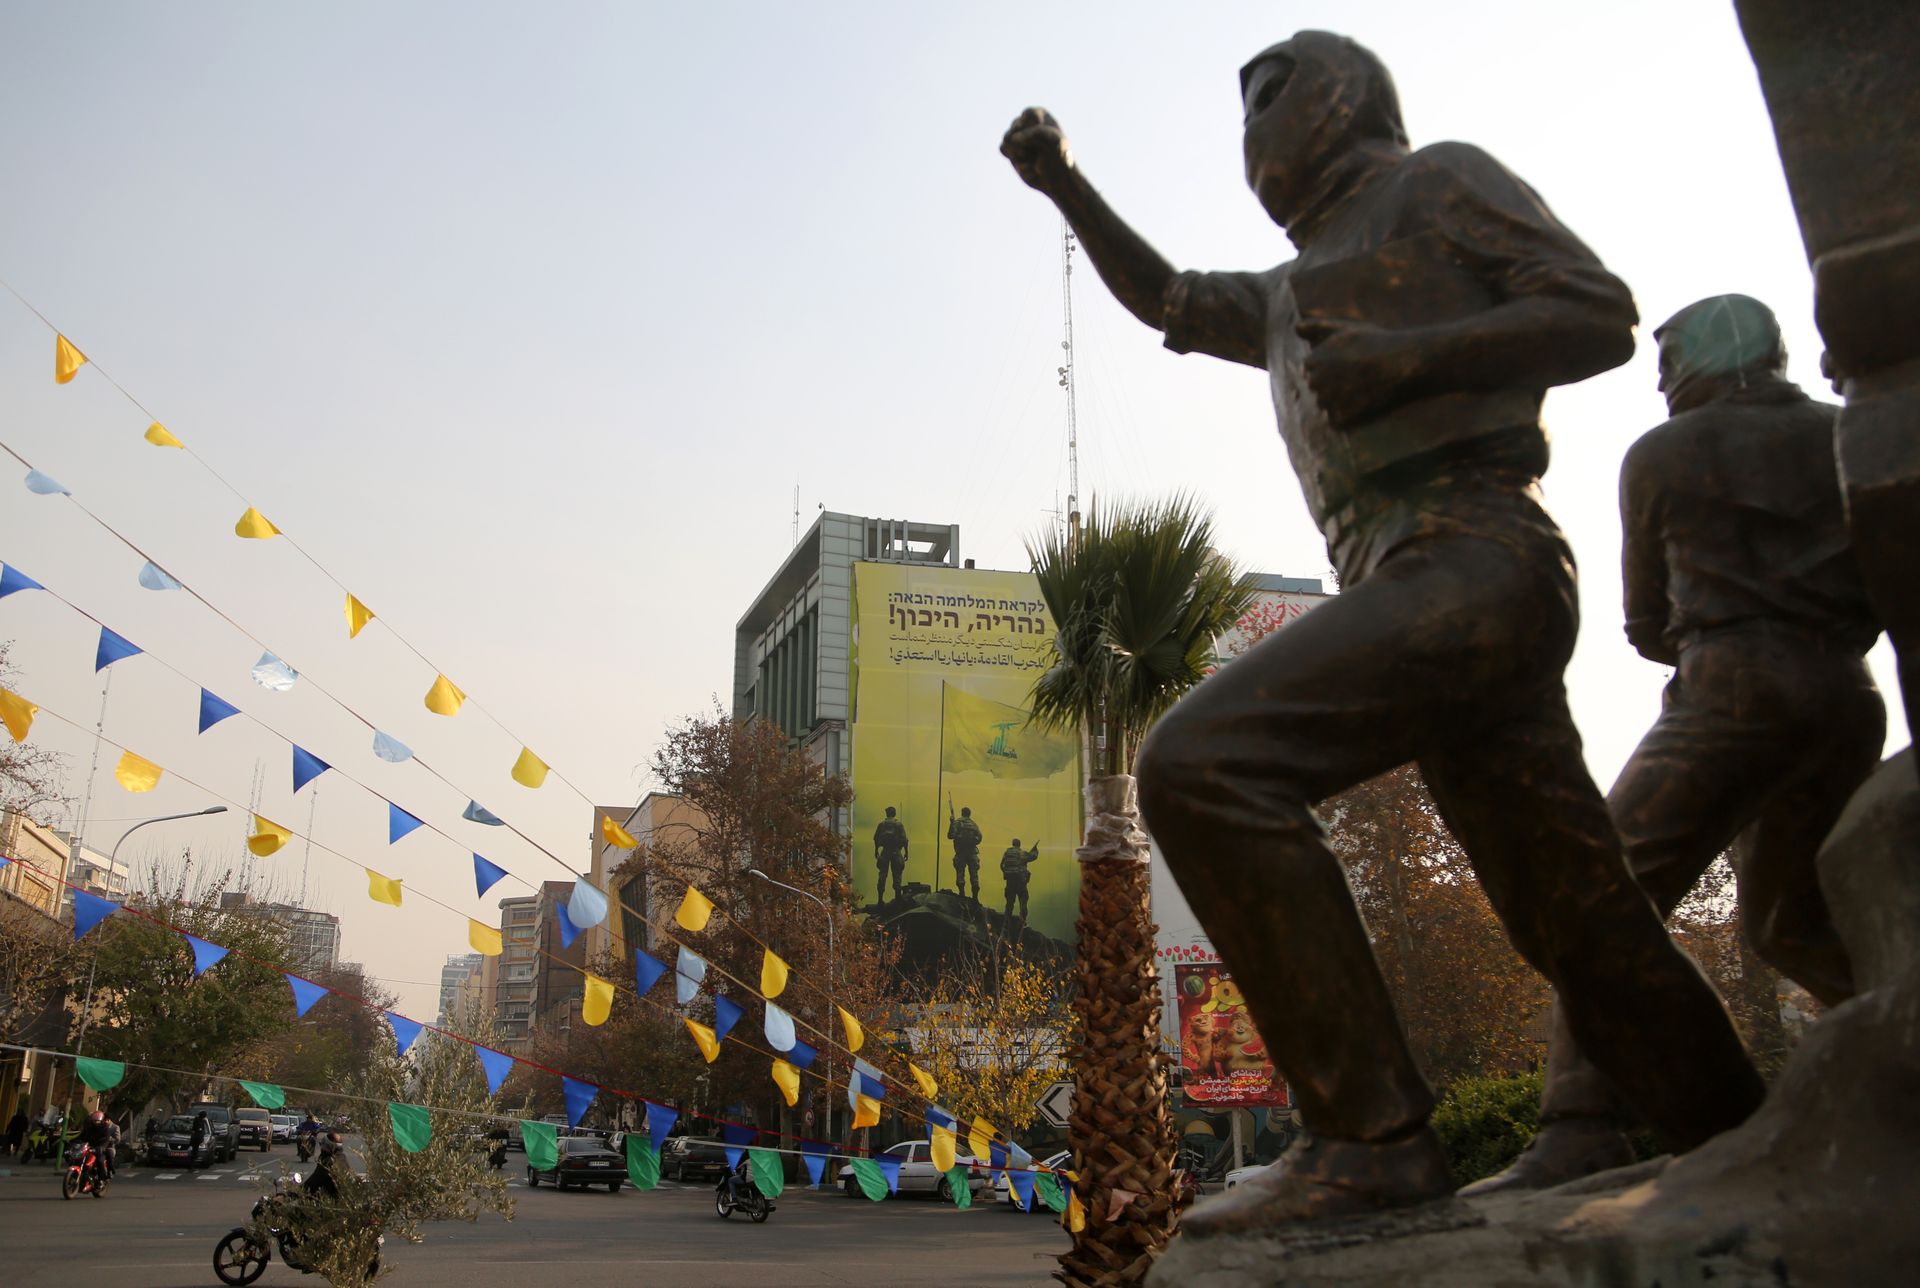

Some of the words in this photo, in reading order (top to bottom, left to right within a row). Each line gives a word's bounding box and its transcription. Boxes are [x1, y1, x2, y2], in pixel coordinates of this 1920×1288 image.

[888, 592, 933, 606] הבאה:
[936, 594, 996, 610] המלחמה
[998, 599, 1045, 616] לקראת
[889, 603, 959, 632] היכון!
[967, 613, 1045, 635] נהריה,
